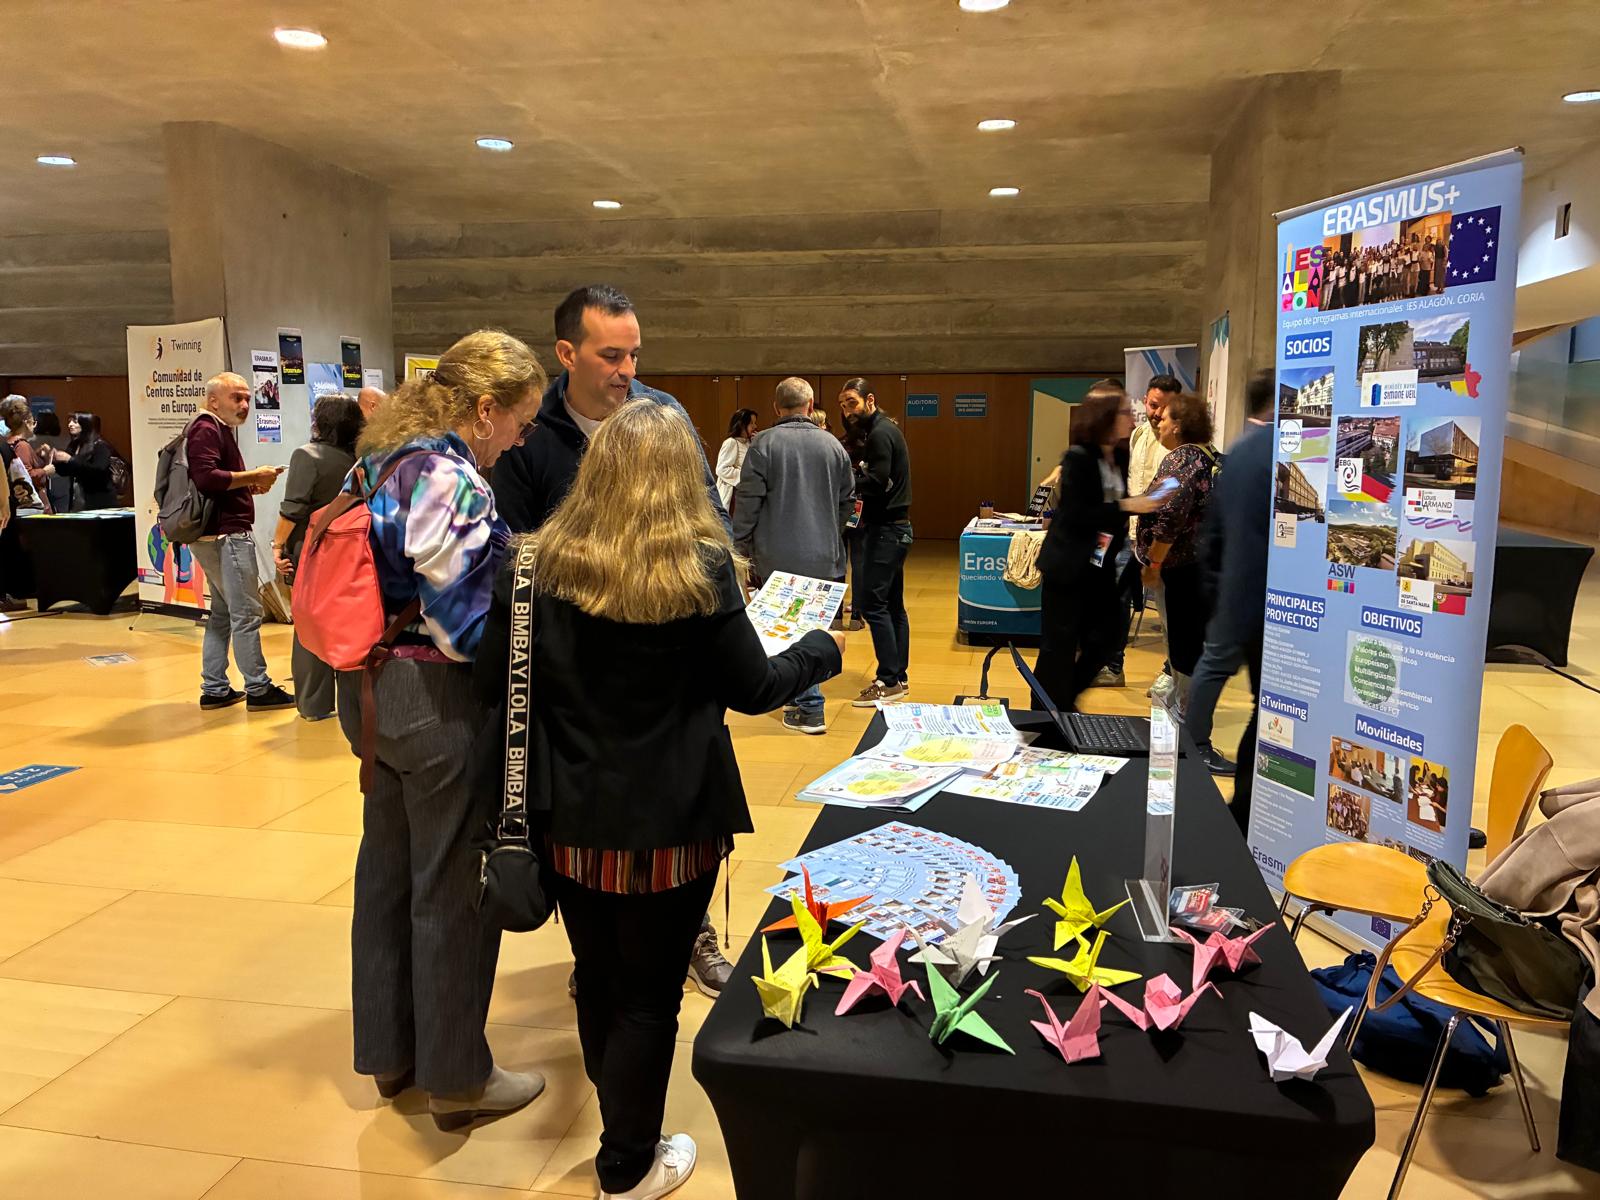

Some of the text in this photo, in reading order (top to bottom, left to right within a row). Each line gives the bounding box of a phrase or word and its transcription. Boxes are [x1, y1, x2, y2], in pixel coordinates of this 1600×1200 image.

[1323, 181, 1461, 236] ERASMUS+
[1282, 318, 1303, 329] Equipo
[1303, 317, 1312, 326] de
[1313, 312, 1349, 325] programas
[1350, 304, 1403, 319] internacionales
[1457, 292, 1485, 304] CORIA
[1286, 337, 1330, 356] SOCIOS
[153, 369, 203, 383] Comunidad de
[146, 383, 206, 398] Centros Escolare
[161, 400, 197, 416] en Europa
[1339, 459, 1352, 467] EBG
[516, 544, 537, 590] LOLA
[964, 552, 1007, 571] Eras
[1328, 563, 1356, 579] ASW
[1266, 592, 1325, 614] PRINCIPALES
[1266, 608, 1318, 629] PROYECTOS
[1363, 610, 1422, 634] OBJETIVOS
[512, 602, 530, 664] BIMBA
[1425, 650, 1455, 663] violencia
[1353, 676, 1386, 690] Conciencia
[509, 683, 527, 735] LOLA
[1261, 696, 1308, 721] eTwinning
[1356, 719, 1423, 752] Movilidades
[506, 747, 525, 809] BIMBA
